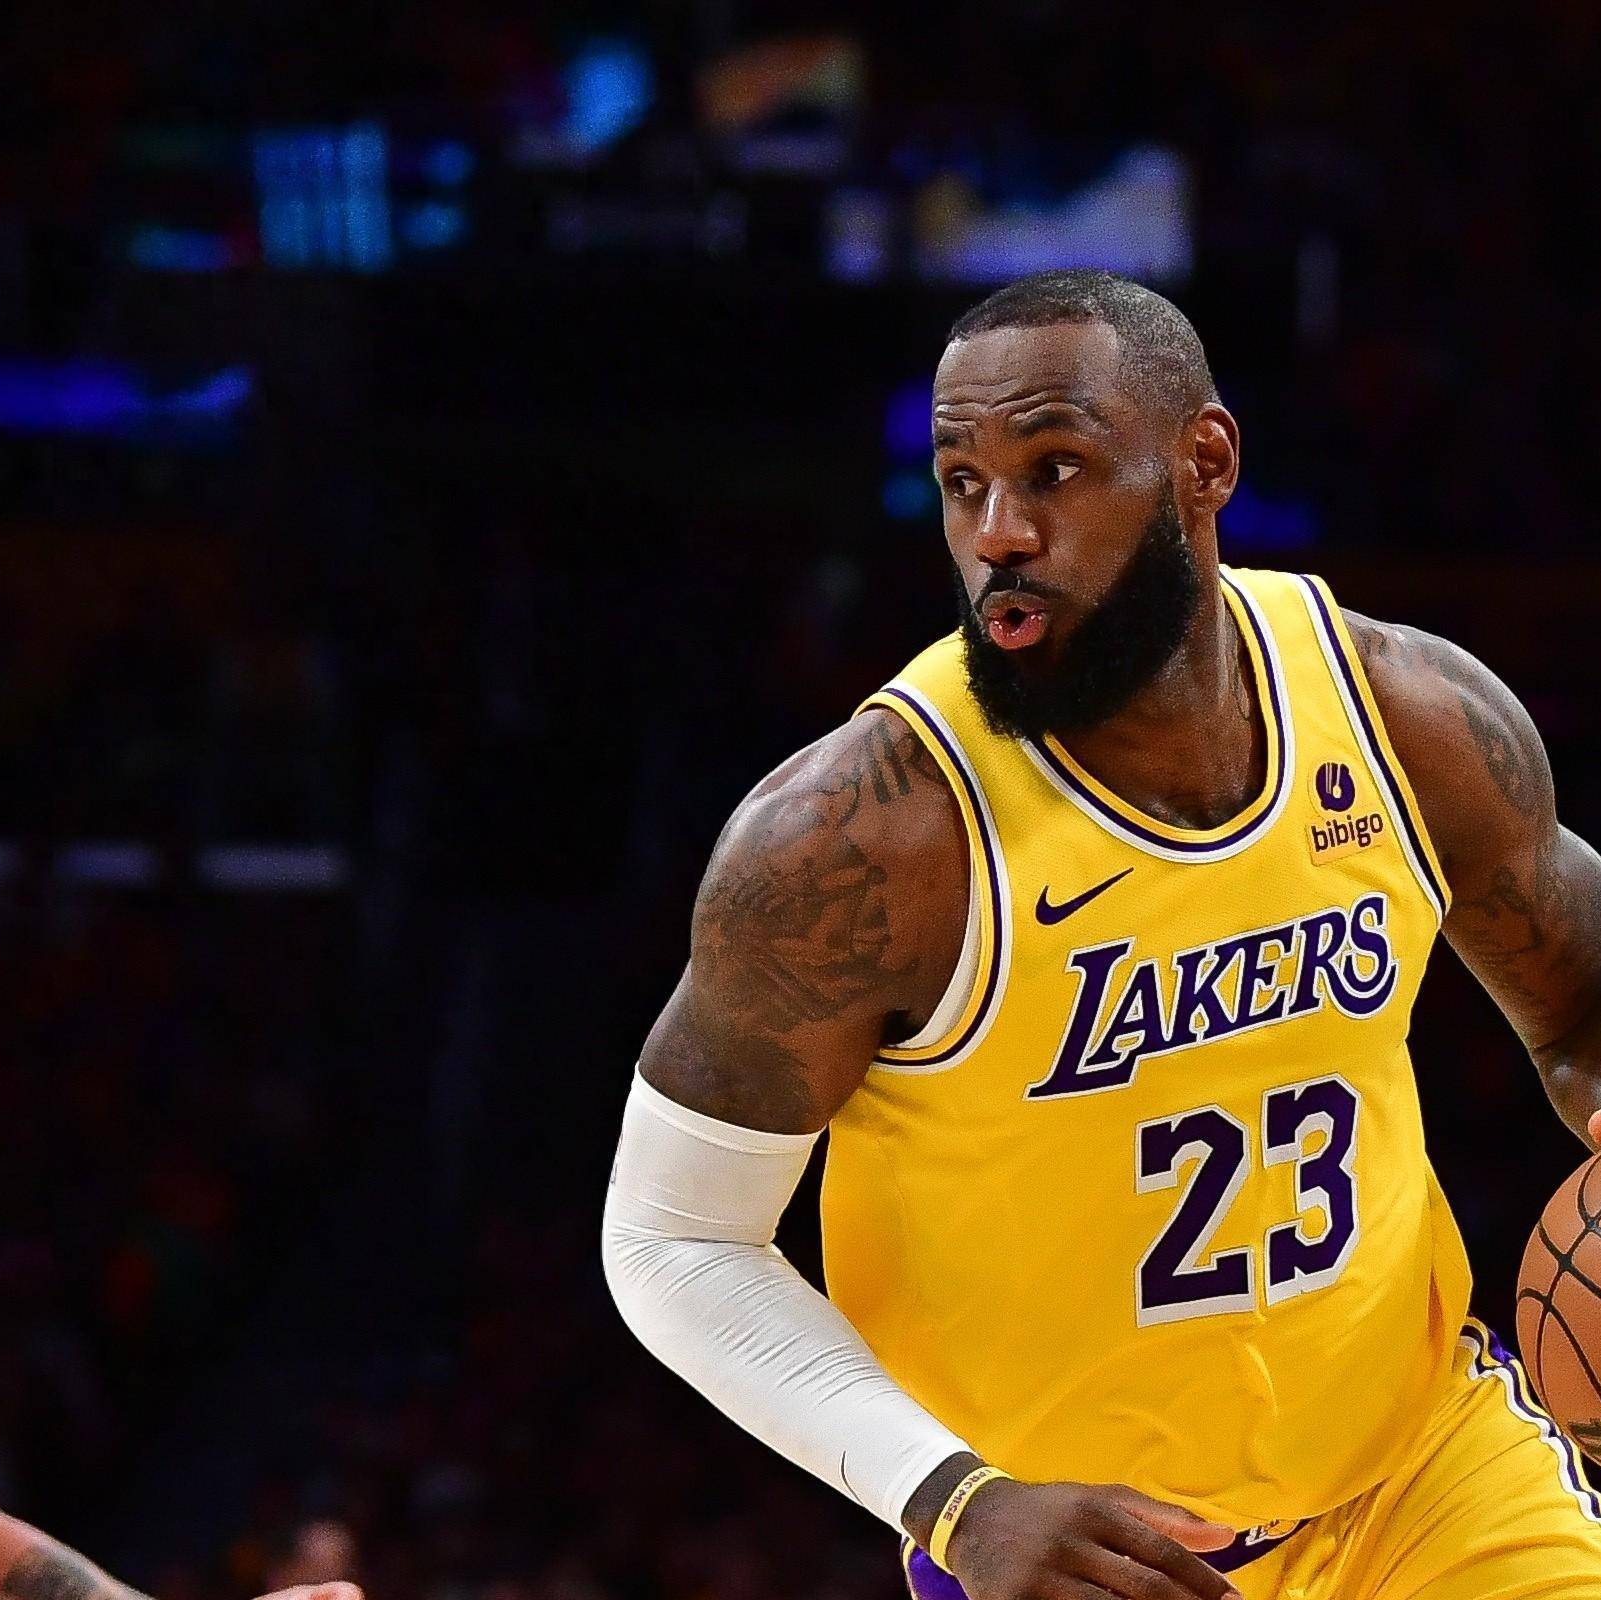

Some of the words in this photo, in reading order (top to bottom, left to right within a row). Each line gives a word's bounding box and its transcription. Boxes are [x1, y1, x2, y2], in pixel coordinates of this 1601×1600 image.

[1311, 813, 1383, 852] bibigo
[1023, 892, 1400, 1102] LAKERS
[1136, 1072, 1361, 1328] 23
